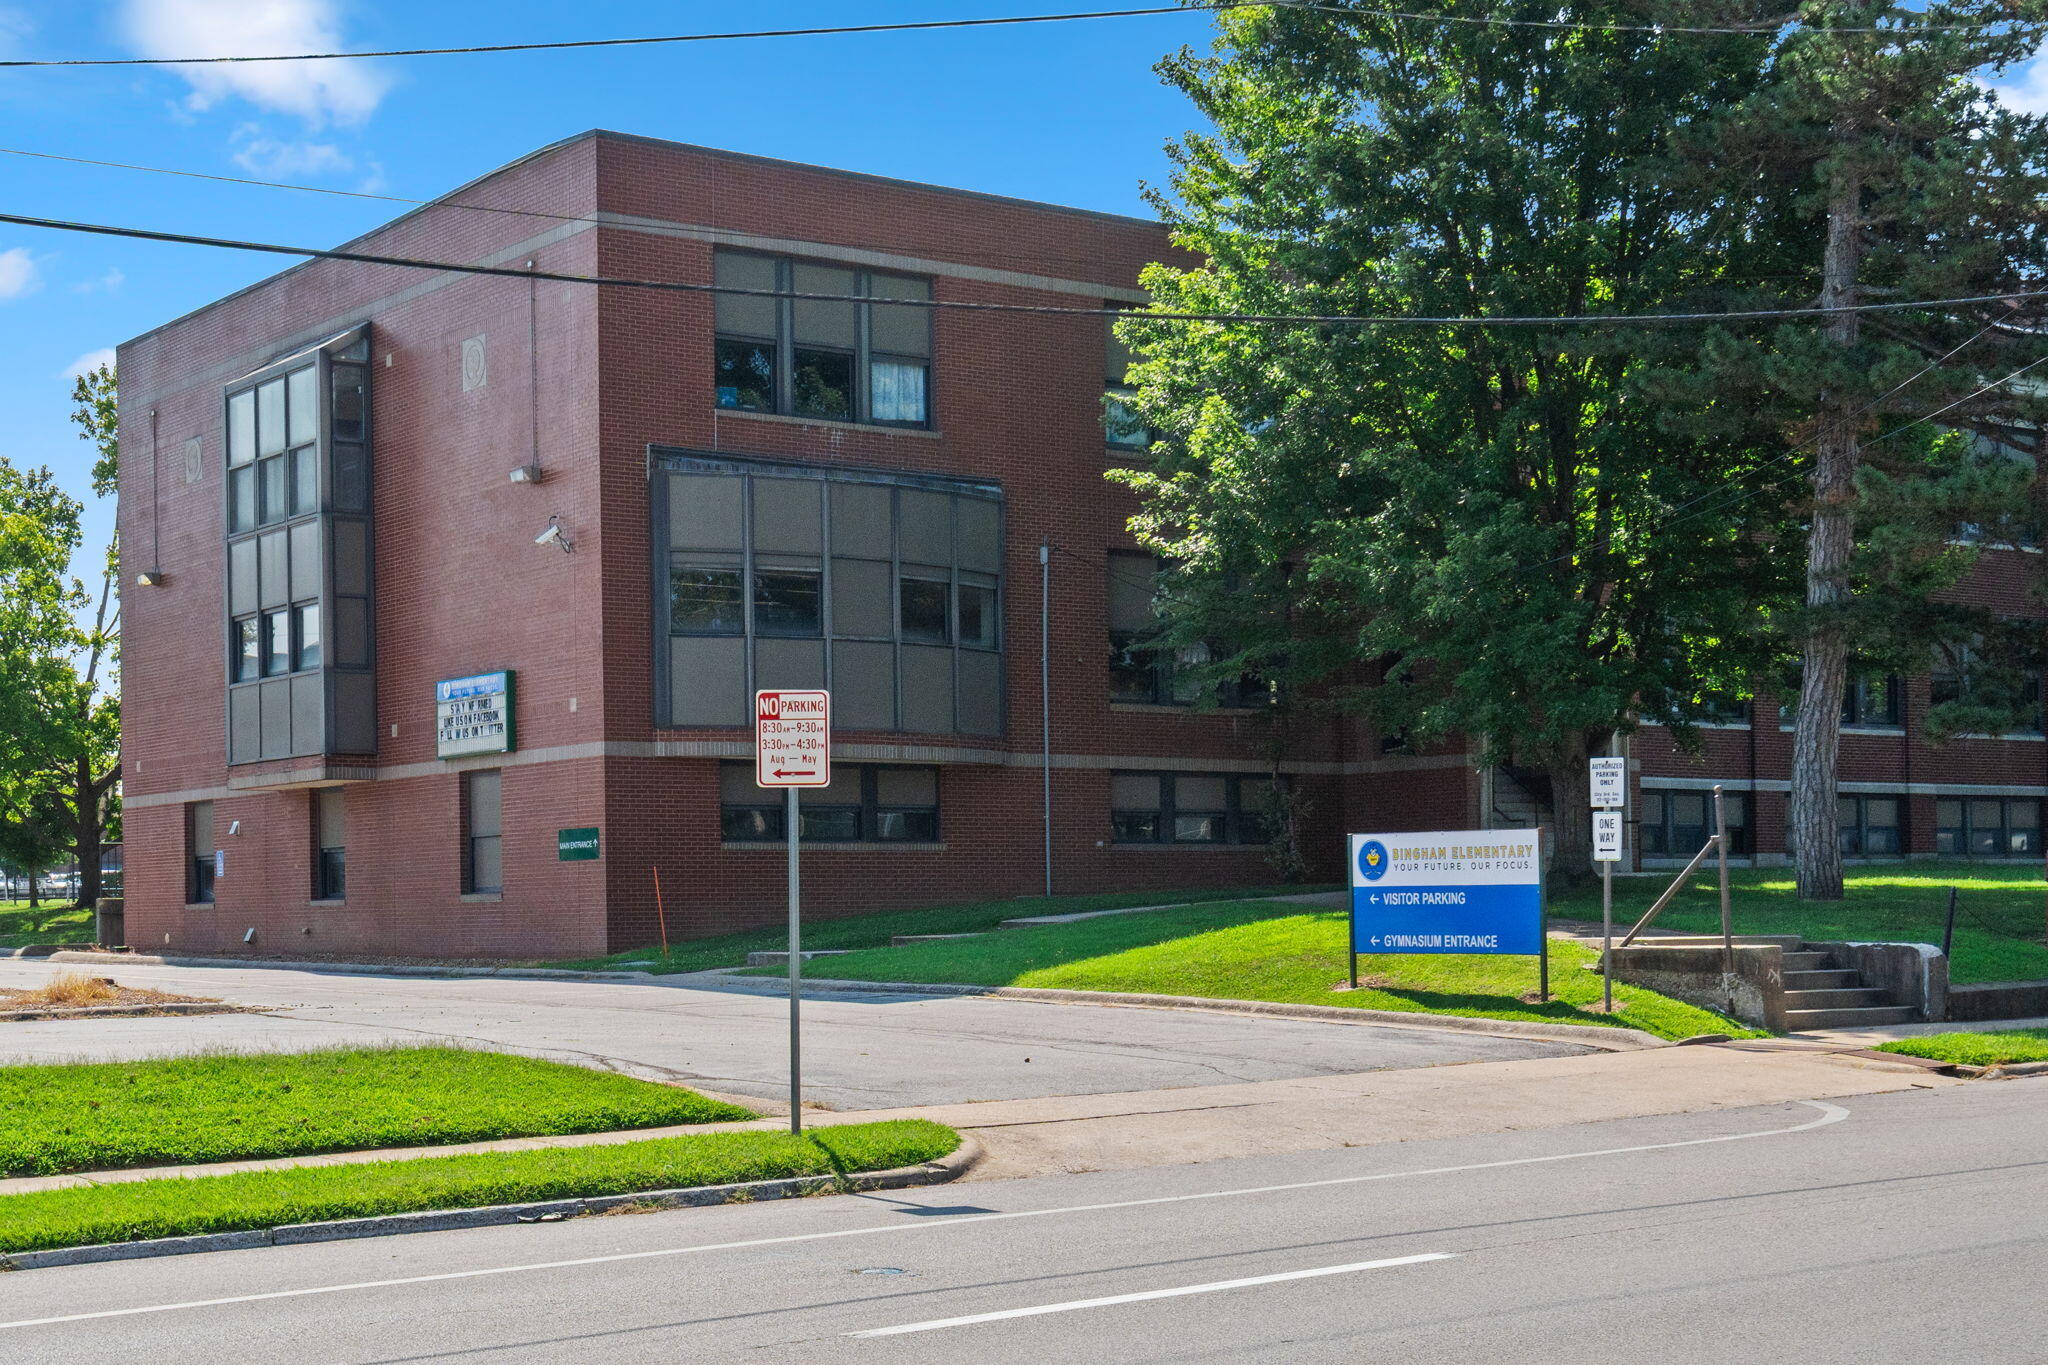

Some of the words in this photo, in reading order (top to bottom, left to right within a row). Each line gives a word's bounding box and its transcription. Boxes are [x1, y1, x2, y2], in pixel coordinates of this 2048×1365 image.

[760, 697, 779, 716] NO
[781, 700, 824, 713] PARKING
[473, 710, 500, 723] FACEBOOK
[770, 755, 785, 765] Aug
[802, 754, 817, 765] May
[1599, 818, 1615, 829] ONE
[1598, 832, 1615, 843] WAY
[1392, 847, 1448, 860] BINGHAM
[1451, 845, 1533, 860] ELEMENTARY
[1393, 863, 1419, 872] YOUR
[1424, 862, 1466, 871] FUTURE.
[1470, 861, 1491, 870] OUR
[1496, 860, 1533, 870] FOCUS.
[1383, 892, 1420, 905] VISITOR
[1422, 892, 1466, 905] PARKING
[1384, 934, 1442, 948] GYMNASIUM
[1444, 935, 1498, 948] ENTRANCE
